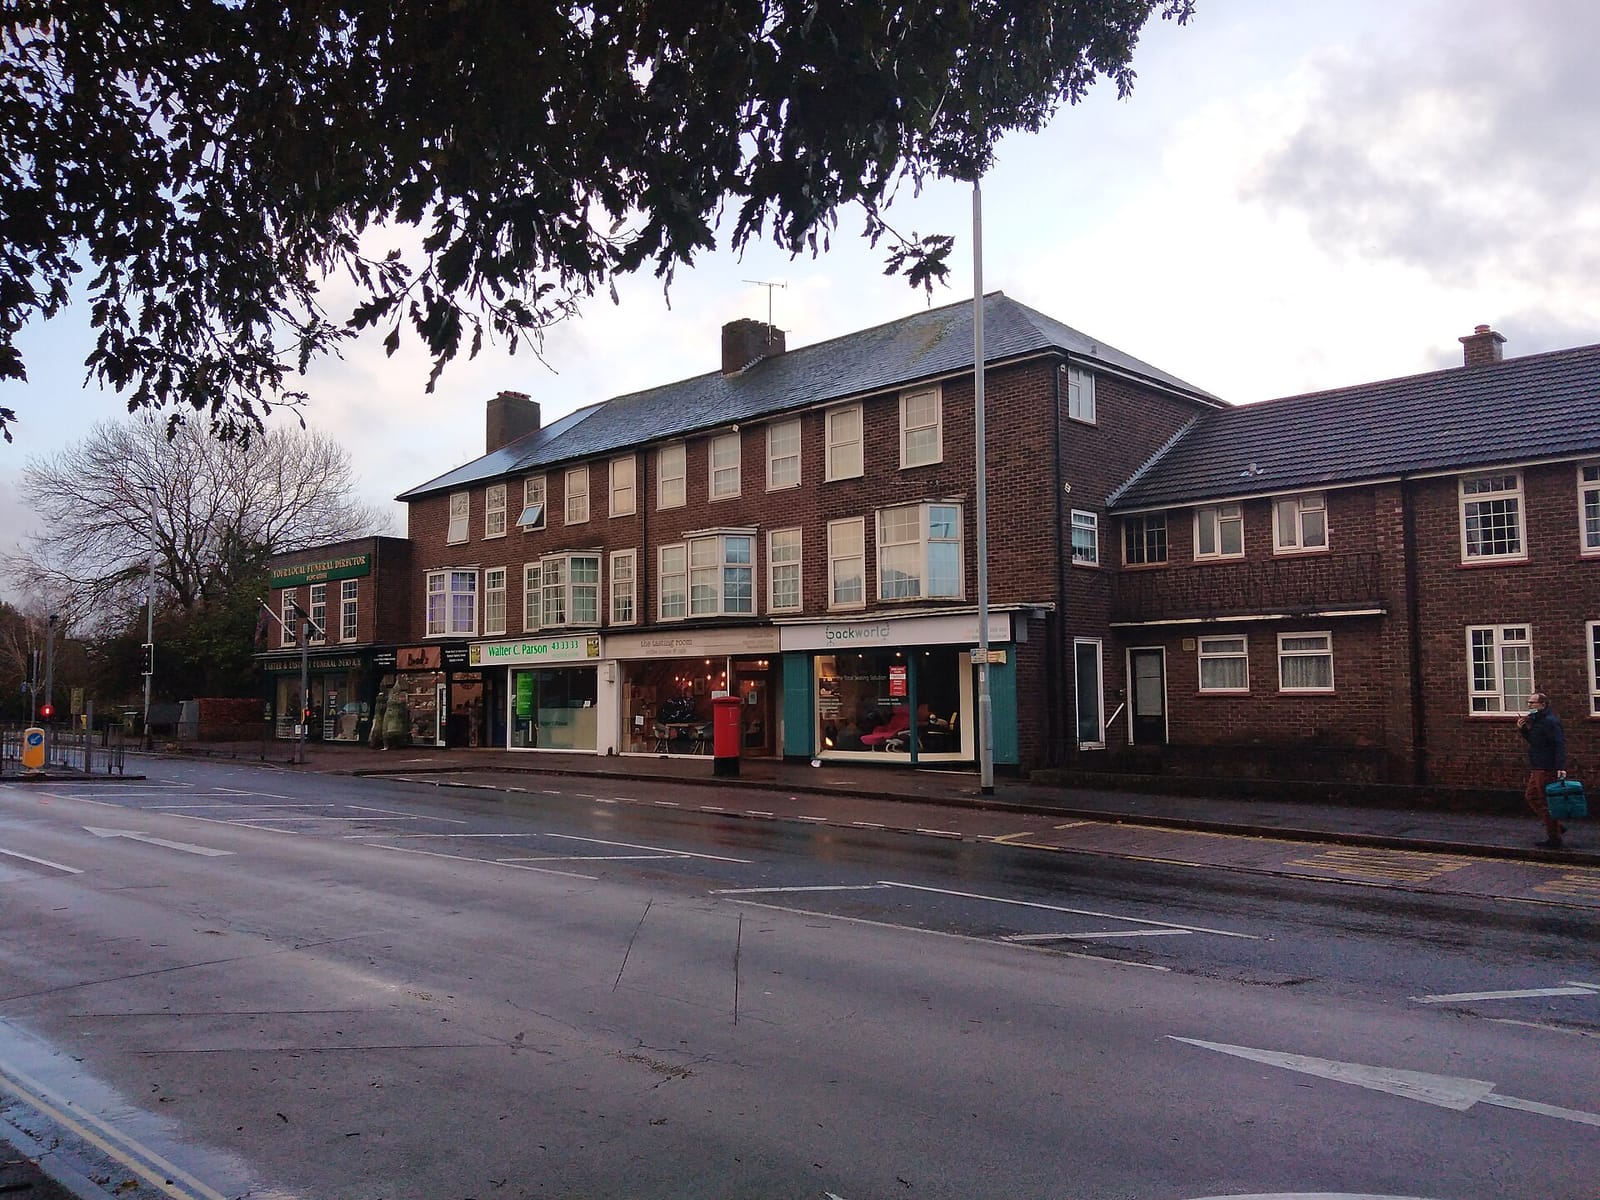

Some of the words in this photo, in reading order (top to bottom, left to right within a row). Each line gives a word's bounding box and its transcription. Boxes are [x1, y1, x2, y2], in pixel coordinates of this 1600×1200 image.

[288, 565, 306, 576] LOCAL
[307, 560, 334, 573] FUNERAL
[335, 556, 366, 569] DIRECTOR
[825, 621, 890, 641] backworld
[488, 645, 511, 657] Walter
[513, 644, 520, 655] C.
[521, 643, 547, 655] Parson
[551, 641, 559, 650] 43
[561, 641, 569, 649] 33
[570, 640, 579, 649] 33
[640, 640, 651, 648] the
[652, 639, 675, 648] tasting
